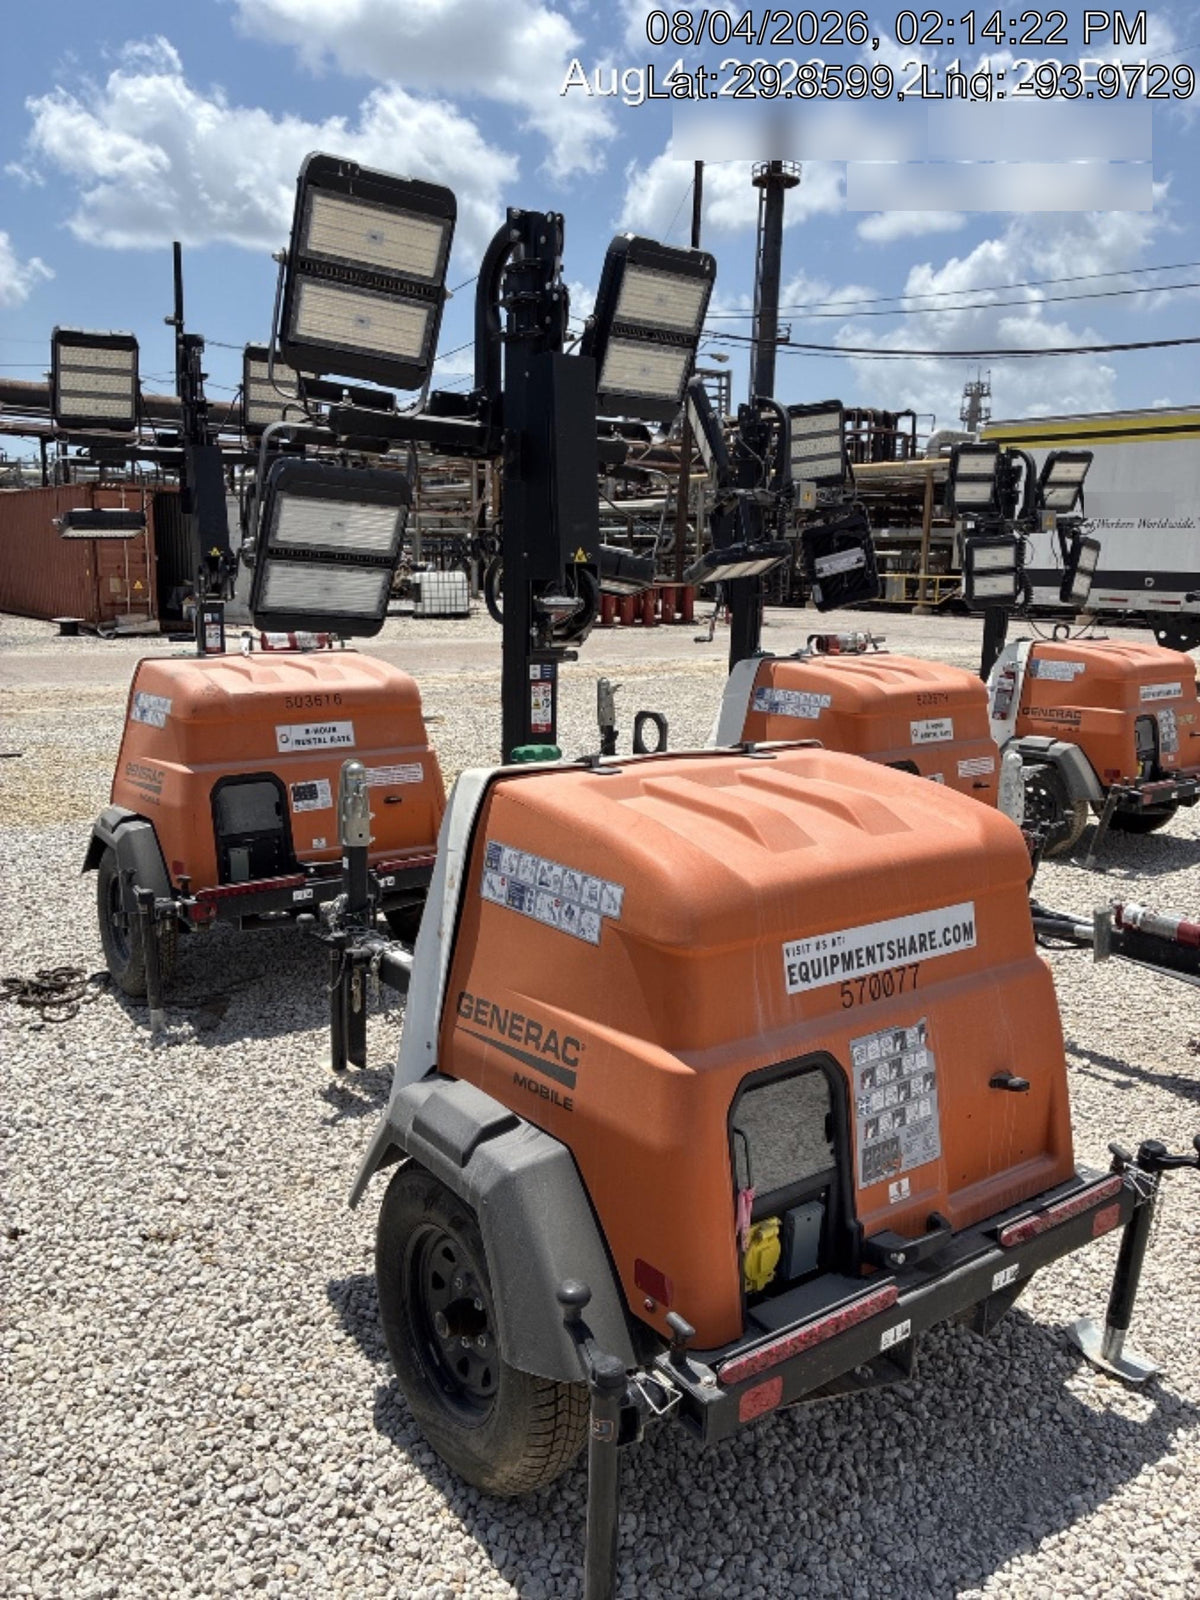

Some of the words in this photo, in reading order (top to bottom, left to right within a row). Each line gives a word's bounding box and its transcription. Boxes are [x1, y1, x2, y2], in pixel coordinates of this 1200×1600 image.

[285, 693, 343, 709] 503616
[1022, 706, 1082, 720] GENERAC
[785, 943, 811, 958] VISIT
[788, 921, 974, 986] EQUIPMENTSHARE.COM
[841, 962, 920, 1009] 570077
[457, 991, 580, 1067] GENERAC
[513, 1071, 573, 1112] MOBILE
